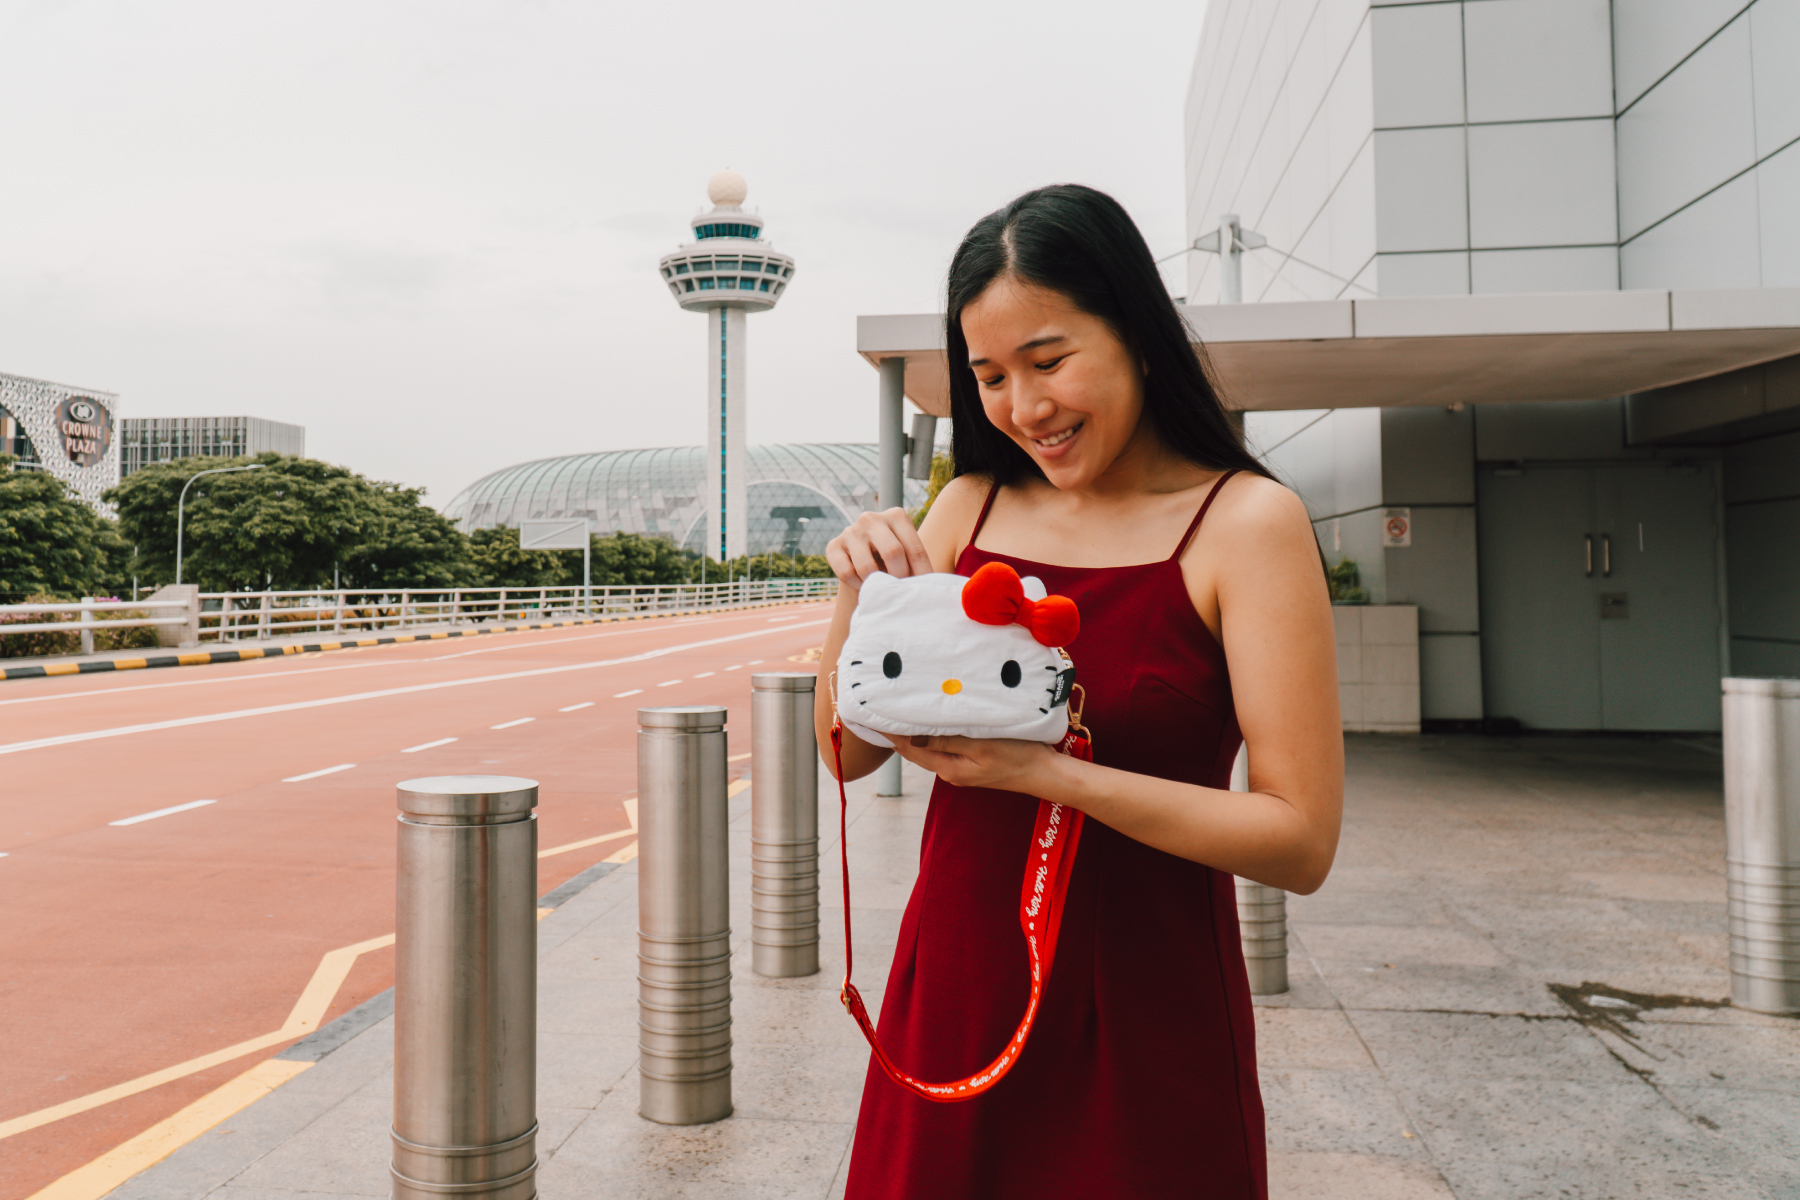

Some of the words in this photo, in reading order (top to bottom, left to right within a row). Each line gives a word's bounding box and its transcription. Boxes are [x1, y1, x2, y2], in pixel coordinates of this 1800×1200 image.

[62, 421, 102, 440] CROWNE
[66, 438, 96, 454] PLAZA
[1050, 802, 1063, 825] Hello
[1038, 825, 1058, 848] Kitty
[1034, 865, 1048, 893] Hello
[1025, 893, 1042, 917] Kitty
